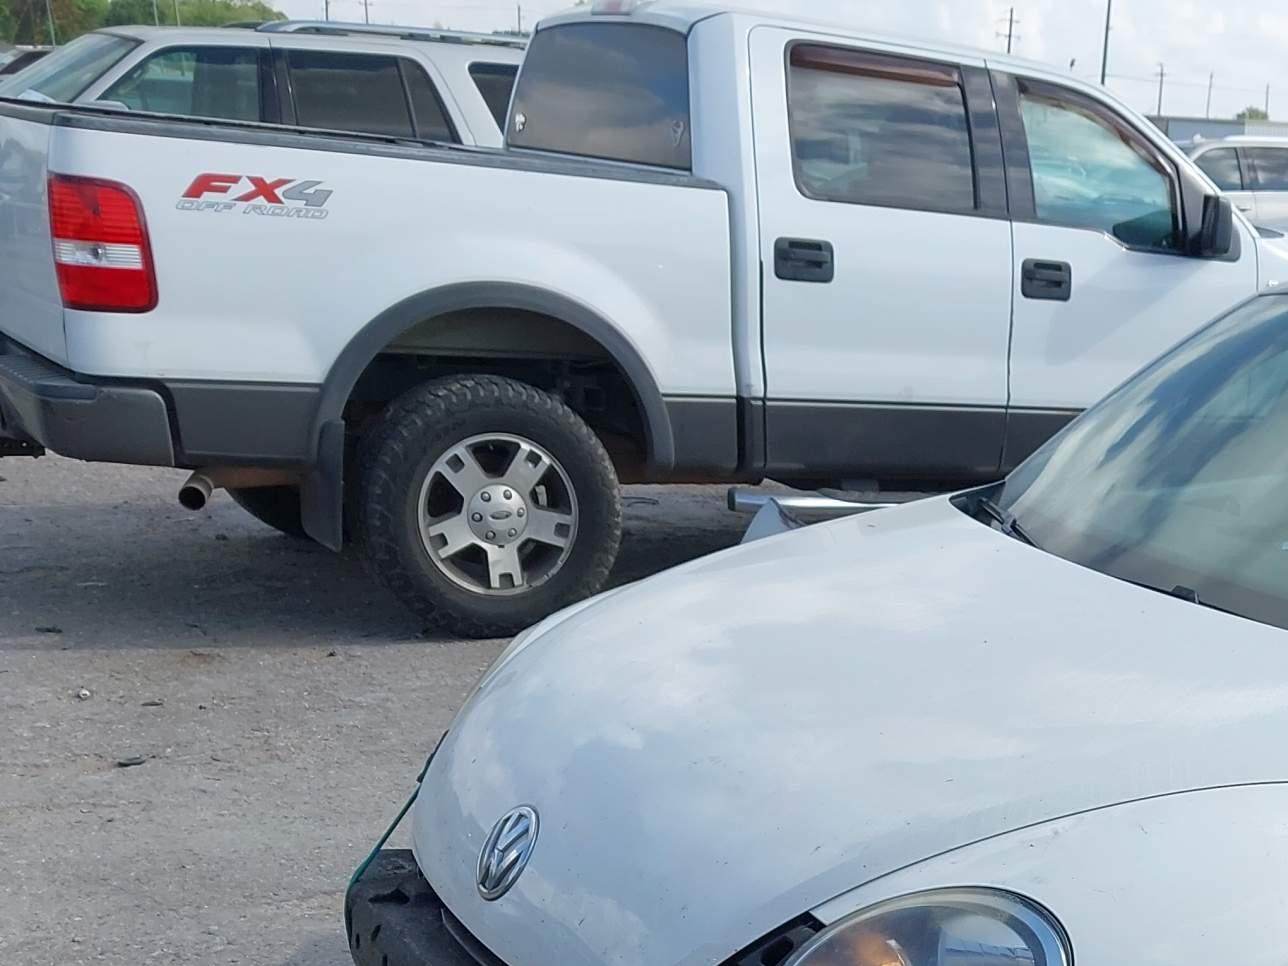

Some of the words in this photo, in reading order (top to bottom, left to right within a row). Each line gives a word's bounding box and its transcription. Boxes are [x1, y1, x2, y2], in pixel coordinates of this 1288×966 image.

[181, 172, 334, 208] FX4
[175, 199, 237, 213] OFF
[242, 203, 329, 220] ROAD
